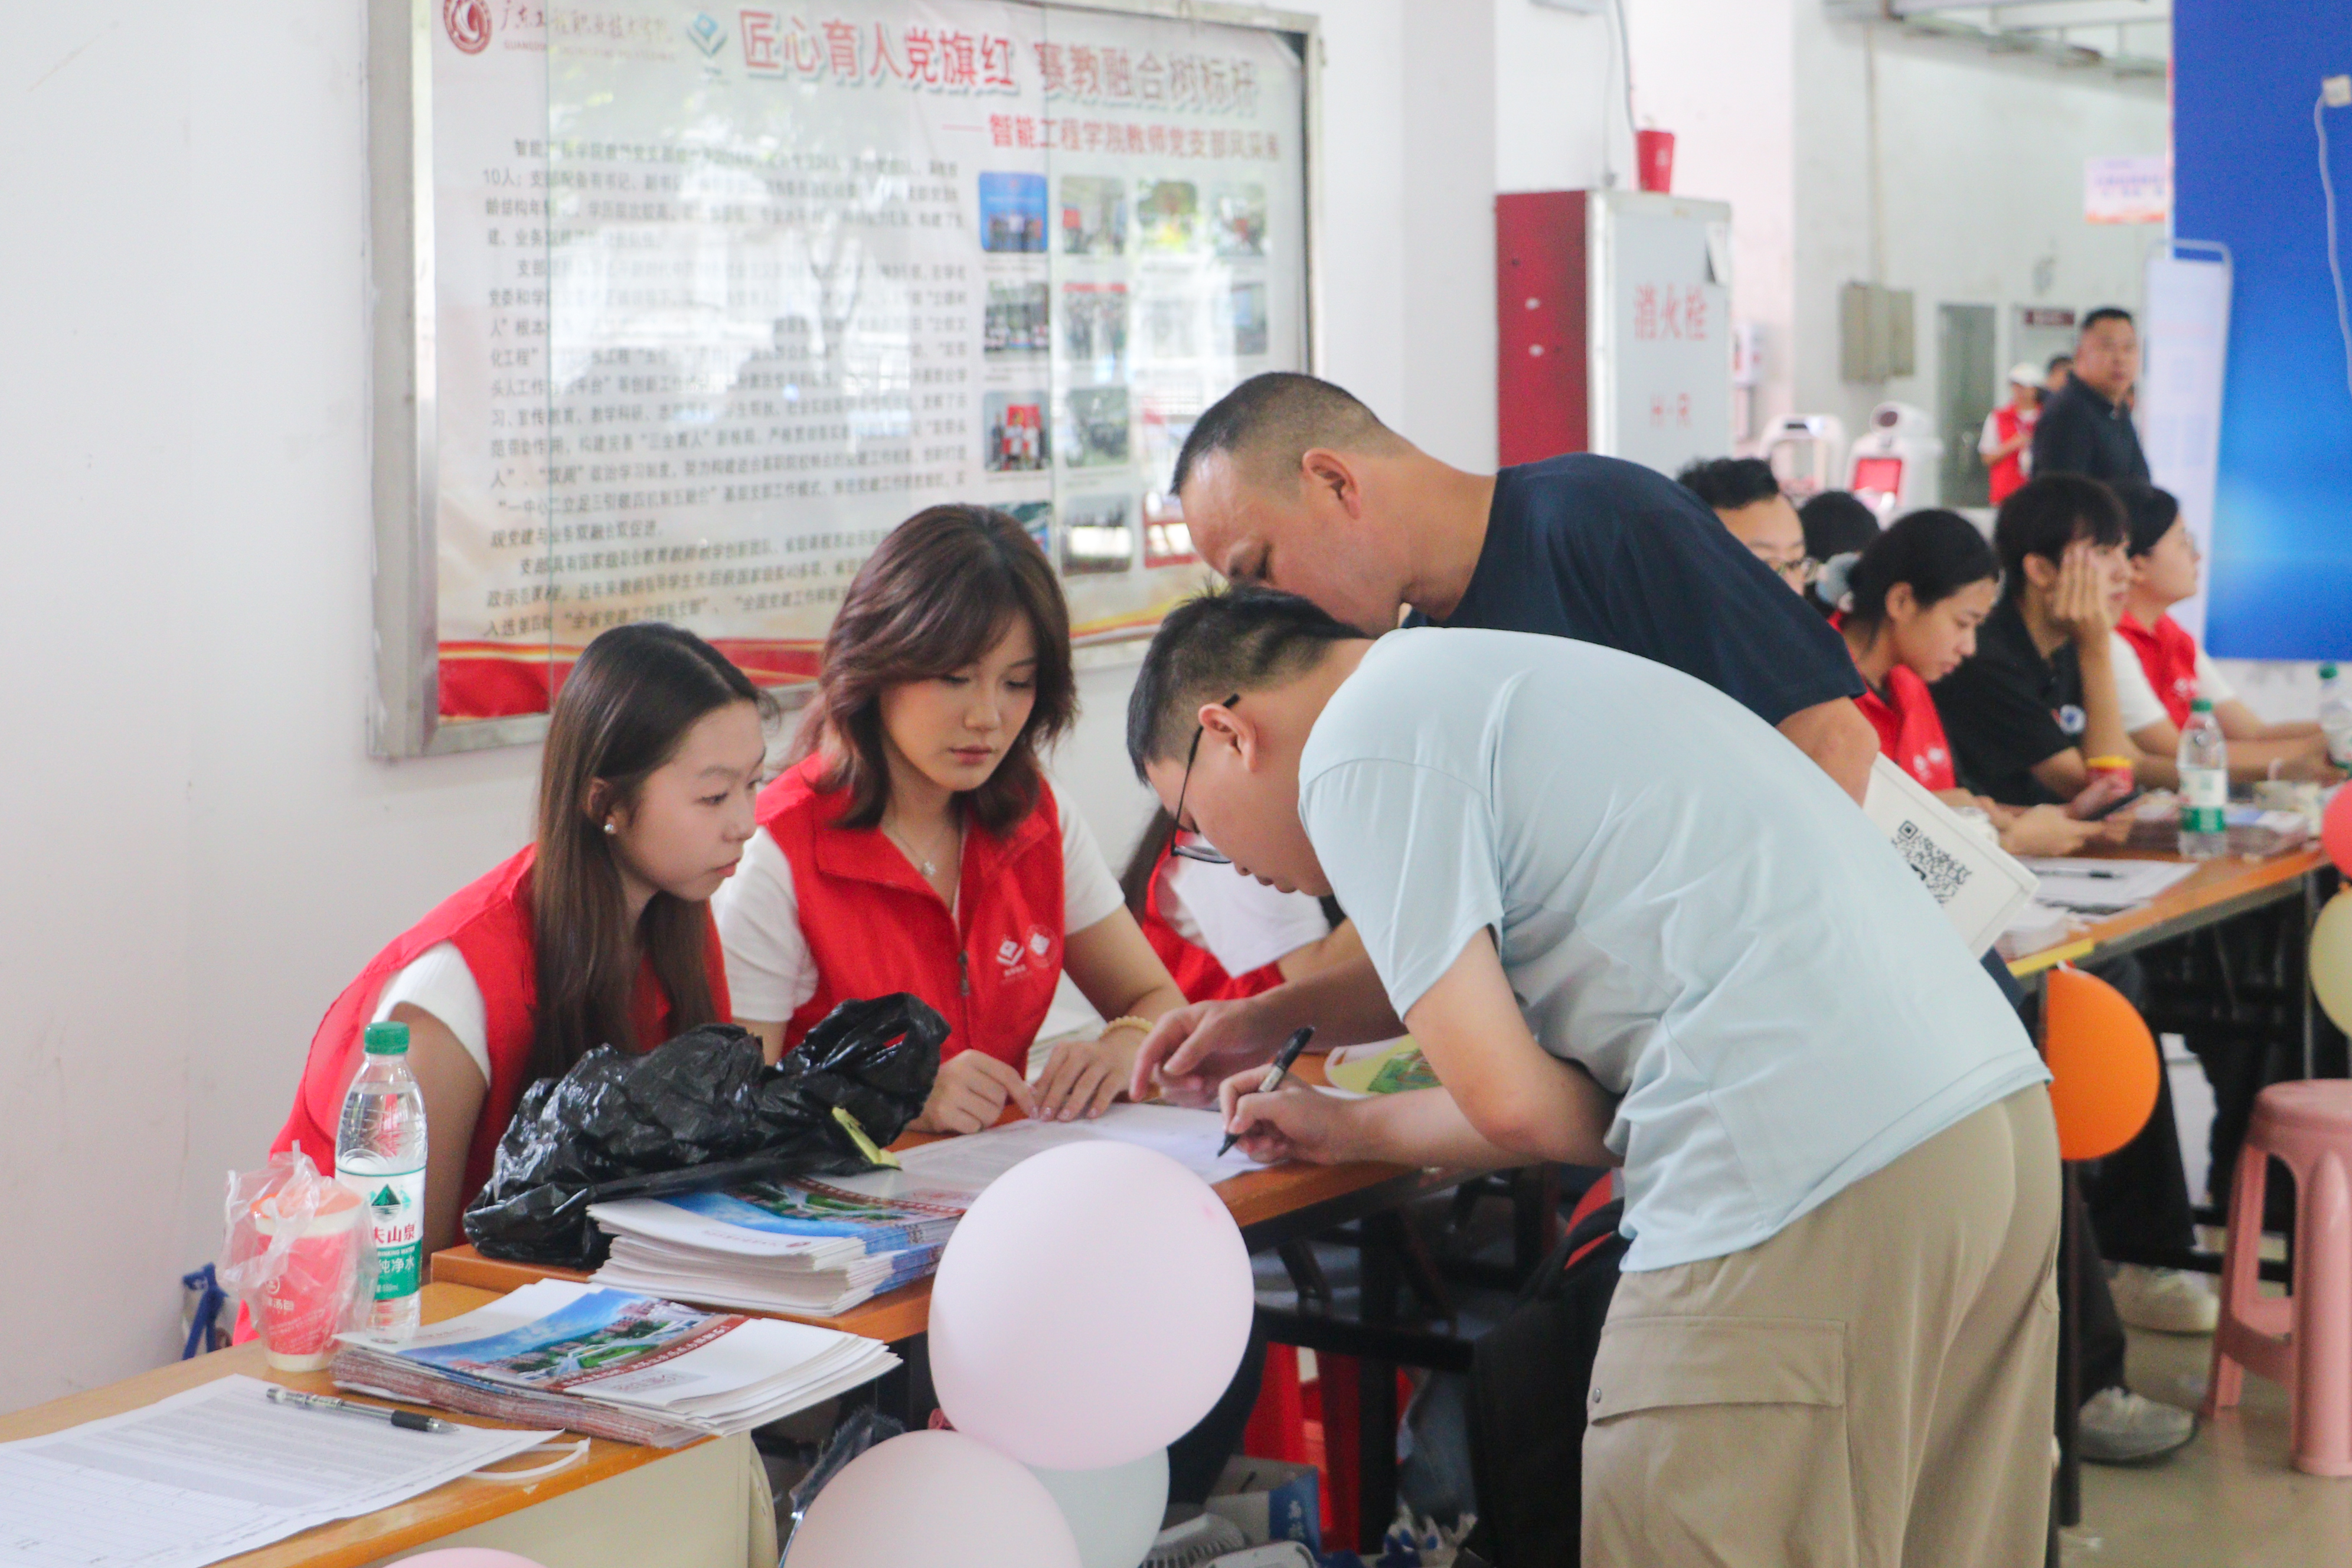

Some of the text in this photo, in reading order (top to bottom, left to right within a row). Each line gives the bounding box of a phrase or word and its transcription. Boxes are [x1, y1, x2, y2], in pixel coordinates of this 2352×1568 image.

[739, 9, 1014, 87] 匠心育人党旗红
[1634, 283, 1707, 341] 消火栓
